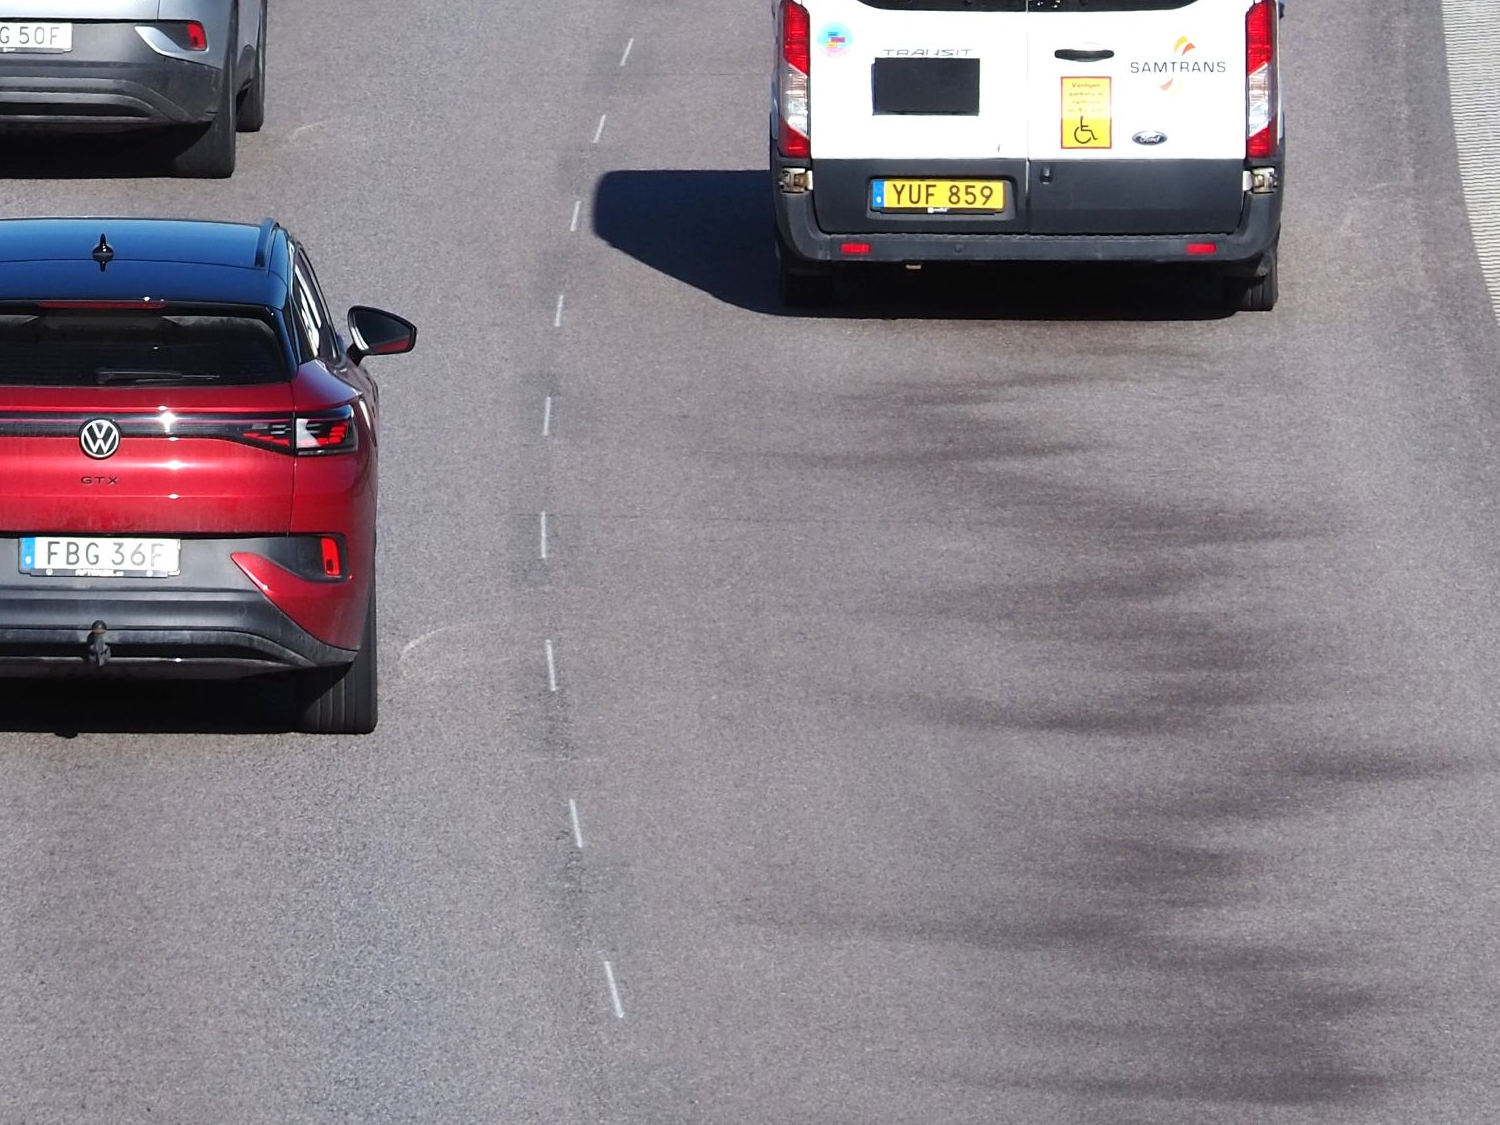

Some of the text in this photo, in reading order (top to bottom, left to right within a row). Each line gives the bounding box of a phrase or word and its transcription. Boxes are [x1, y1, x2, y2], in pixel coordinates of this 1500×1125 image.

[18, 26, 61, 45] 50F
[883, 48, 973, 57] TRANSIT
[1130, 61, 1226, 74] SAMTRANS
[892, 183, 994, 206] YUF 859
[80, 418, 120, 459] VW
[80, 476, 118, 484] GTX
[46, 540, 165, 567] FBG 36F
